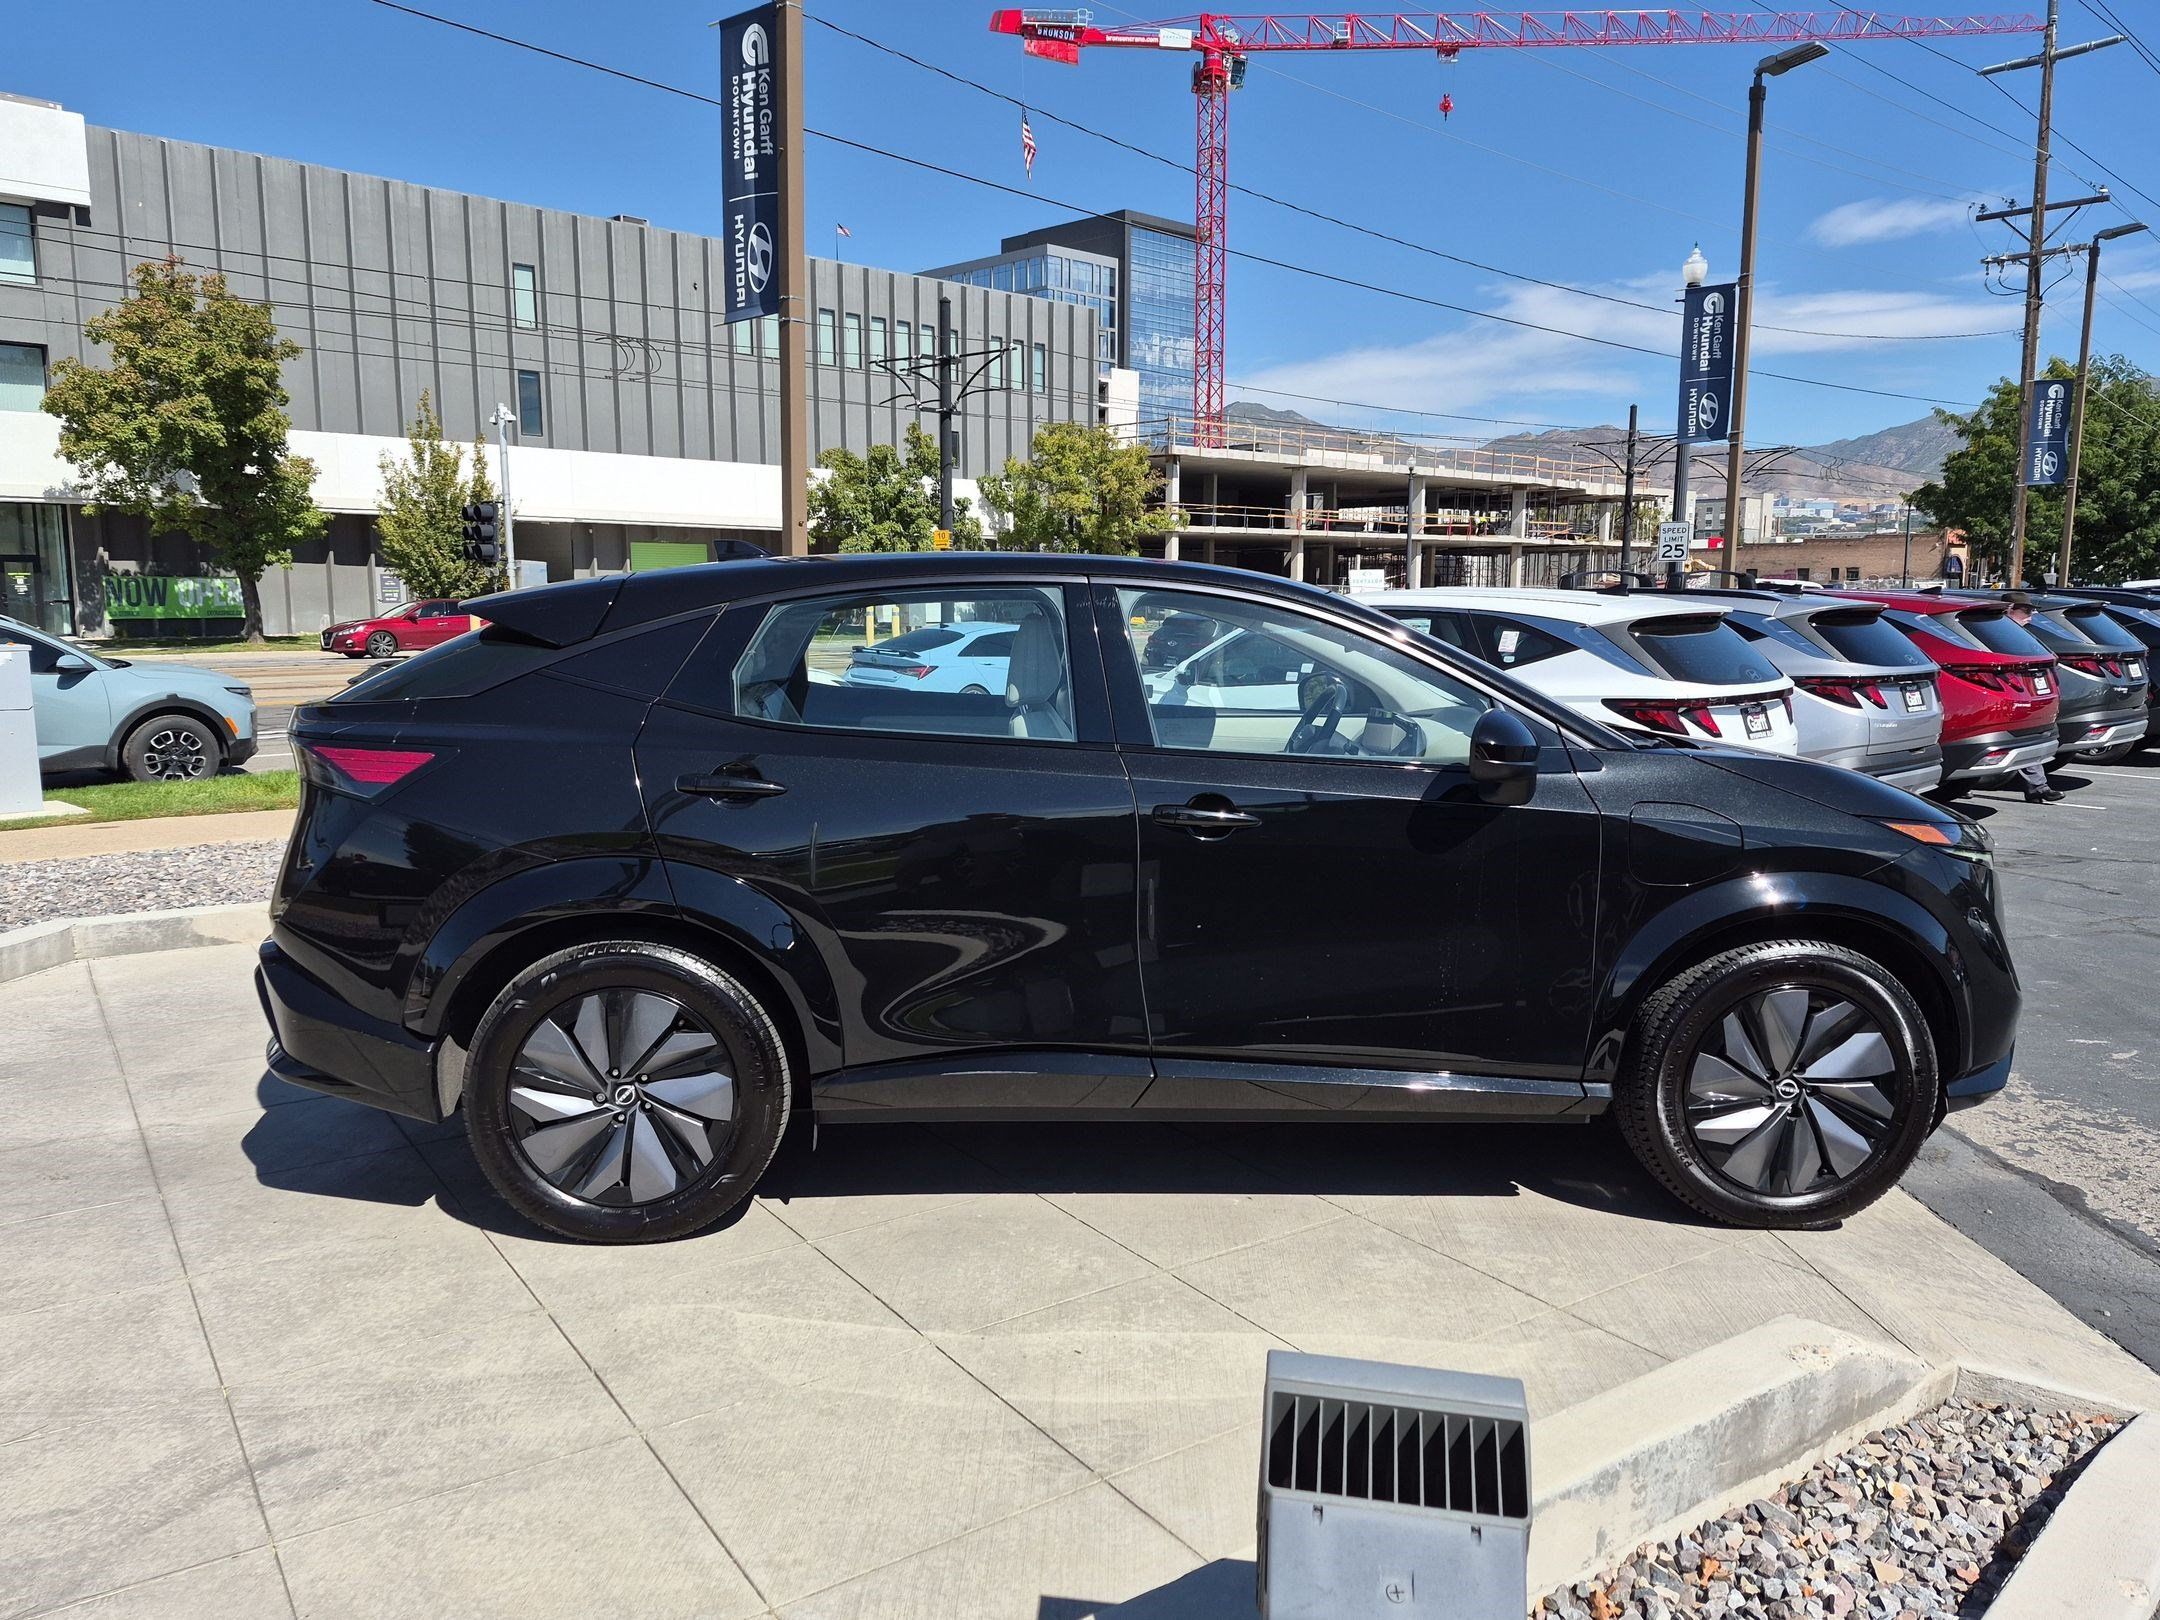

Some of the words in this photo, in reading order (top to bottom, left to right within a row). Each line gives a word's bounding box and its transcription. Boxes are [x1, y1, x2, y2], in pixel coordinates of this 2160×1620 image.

[758, 67, 771, 106] Ken
[732, 75, 740, 160] DOWNTOWN
[741, 71, 758, 180] Hyundai
[759, 108, 773, 155] Garff
[734, 214, 746, 308] HYUNDAI
[1691, 317, 1699, 361] DOWNTOWN
[1699, 316, 1714, 372] Hyundai
[1714, 315, 1724, 334] Ken
[1713, 335, 1723, 359] Garff
[1688, 388, 1698, 437] HYUNDAI
[2043, 399, 2056, 437] Hyundai
[2033, 447, 2042, 481] HYUNDAI
[937, 532, 946, 540] 10
[1661, 544, 1685, 558] 25
[105, 577, 168, 607] NOW
[178, 577, 244, 607] OPEN
